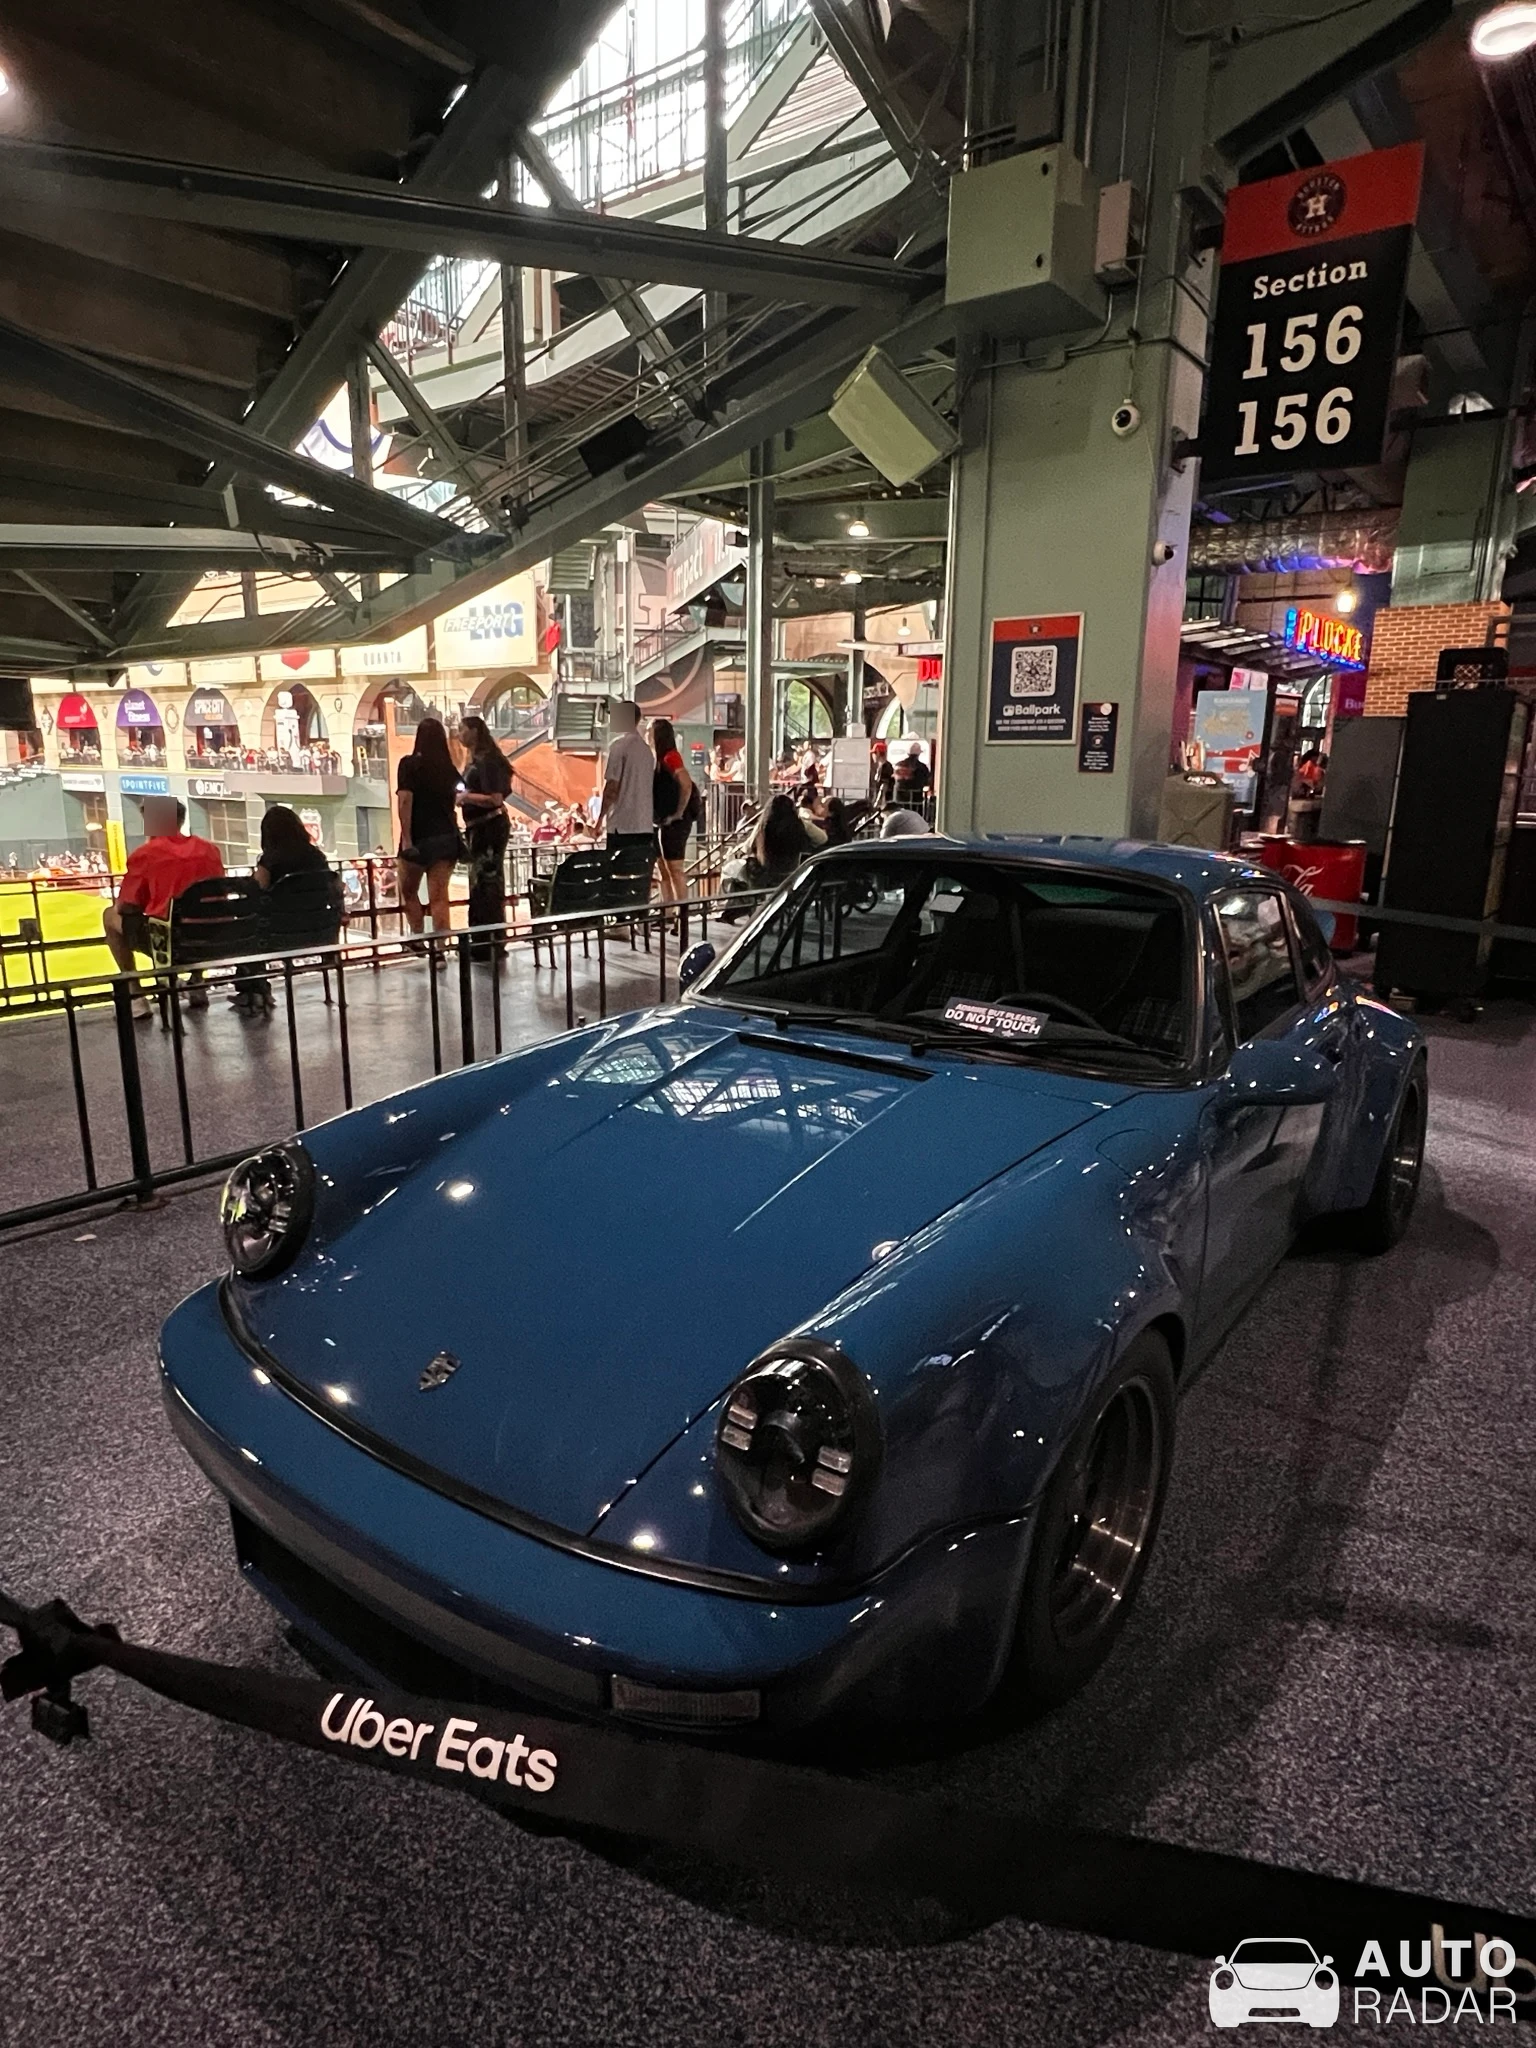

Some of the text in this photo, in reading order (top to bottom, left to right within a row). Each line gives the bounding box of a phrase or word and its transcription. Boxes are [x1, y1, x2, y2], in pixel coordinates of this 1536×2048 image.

[1253, 258, 1368, 300] Section
[1241, 305, 1364, 380] 156
[1234, 387, 1354, 456] 156
[443, 613, 513, 633] FREEPORT
[363, 651, 402, 666] QUANTA
[1015, 704, 1061, 716] Ballpark
[945, 1009, 964, 1020] DO
[965, 1013, 995, 1025] NOT
[995, 1017, 1041, 1035] TOUCH
[988, 1008, 1006, 1018] BUT
[1006, 1012, 1038, 1023] PLEASE
[320, 1692, 558, 1793] Uber Eats
